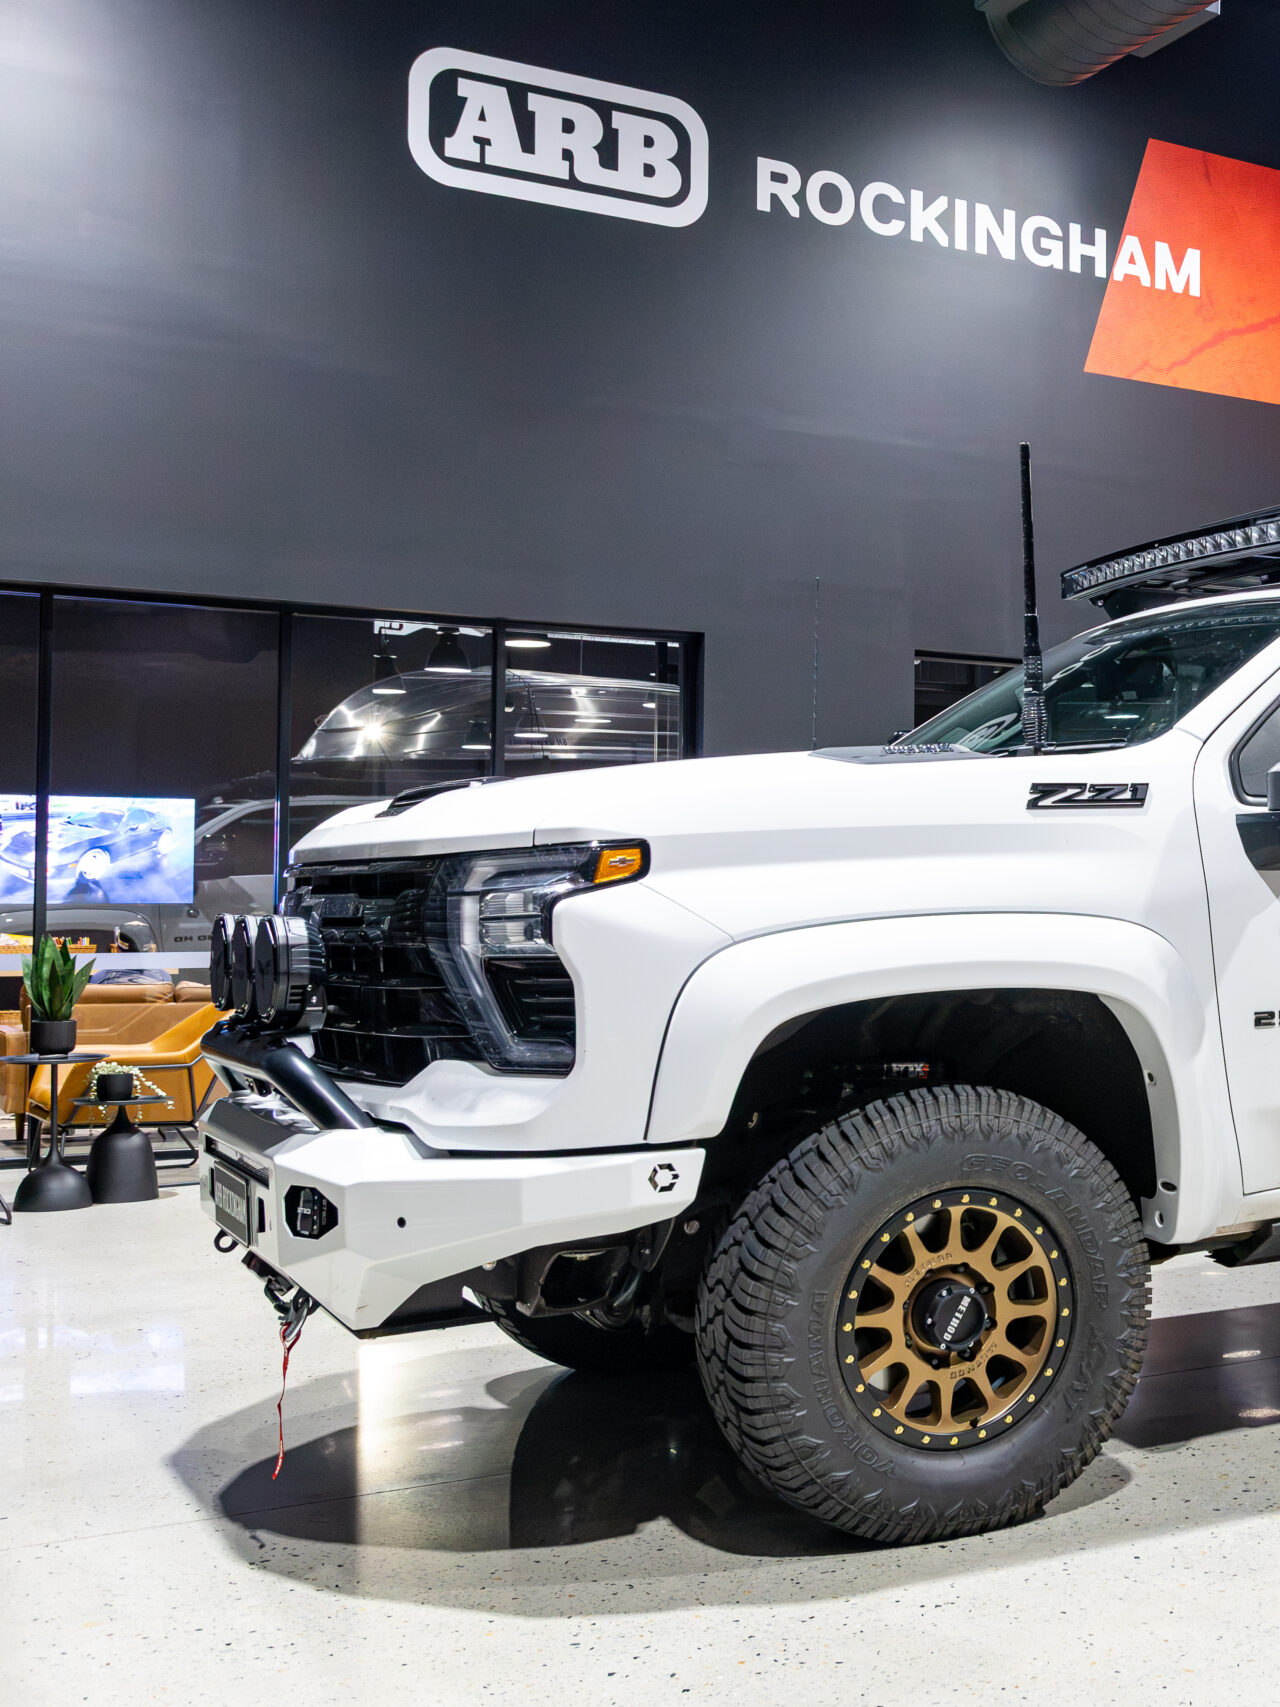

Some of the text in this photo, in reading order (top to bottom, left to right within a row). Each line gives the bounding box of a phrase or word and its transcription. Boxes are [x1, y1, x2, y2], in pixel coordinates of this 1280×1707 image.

[444, 76, 1202, 298] ARB ROCKINGHAM
[1026, 782, 1149, 810] Z71
[942, 1294, 972, 1342] METHOD
